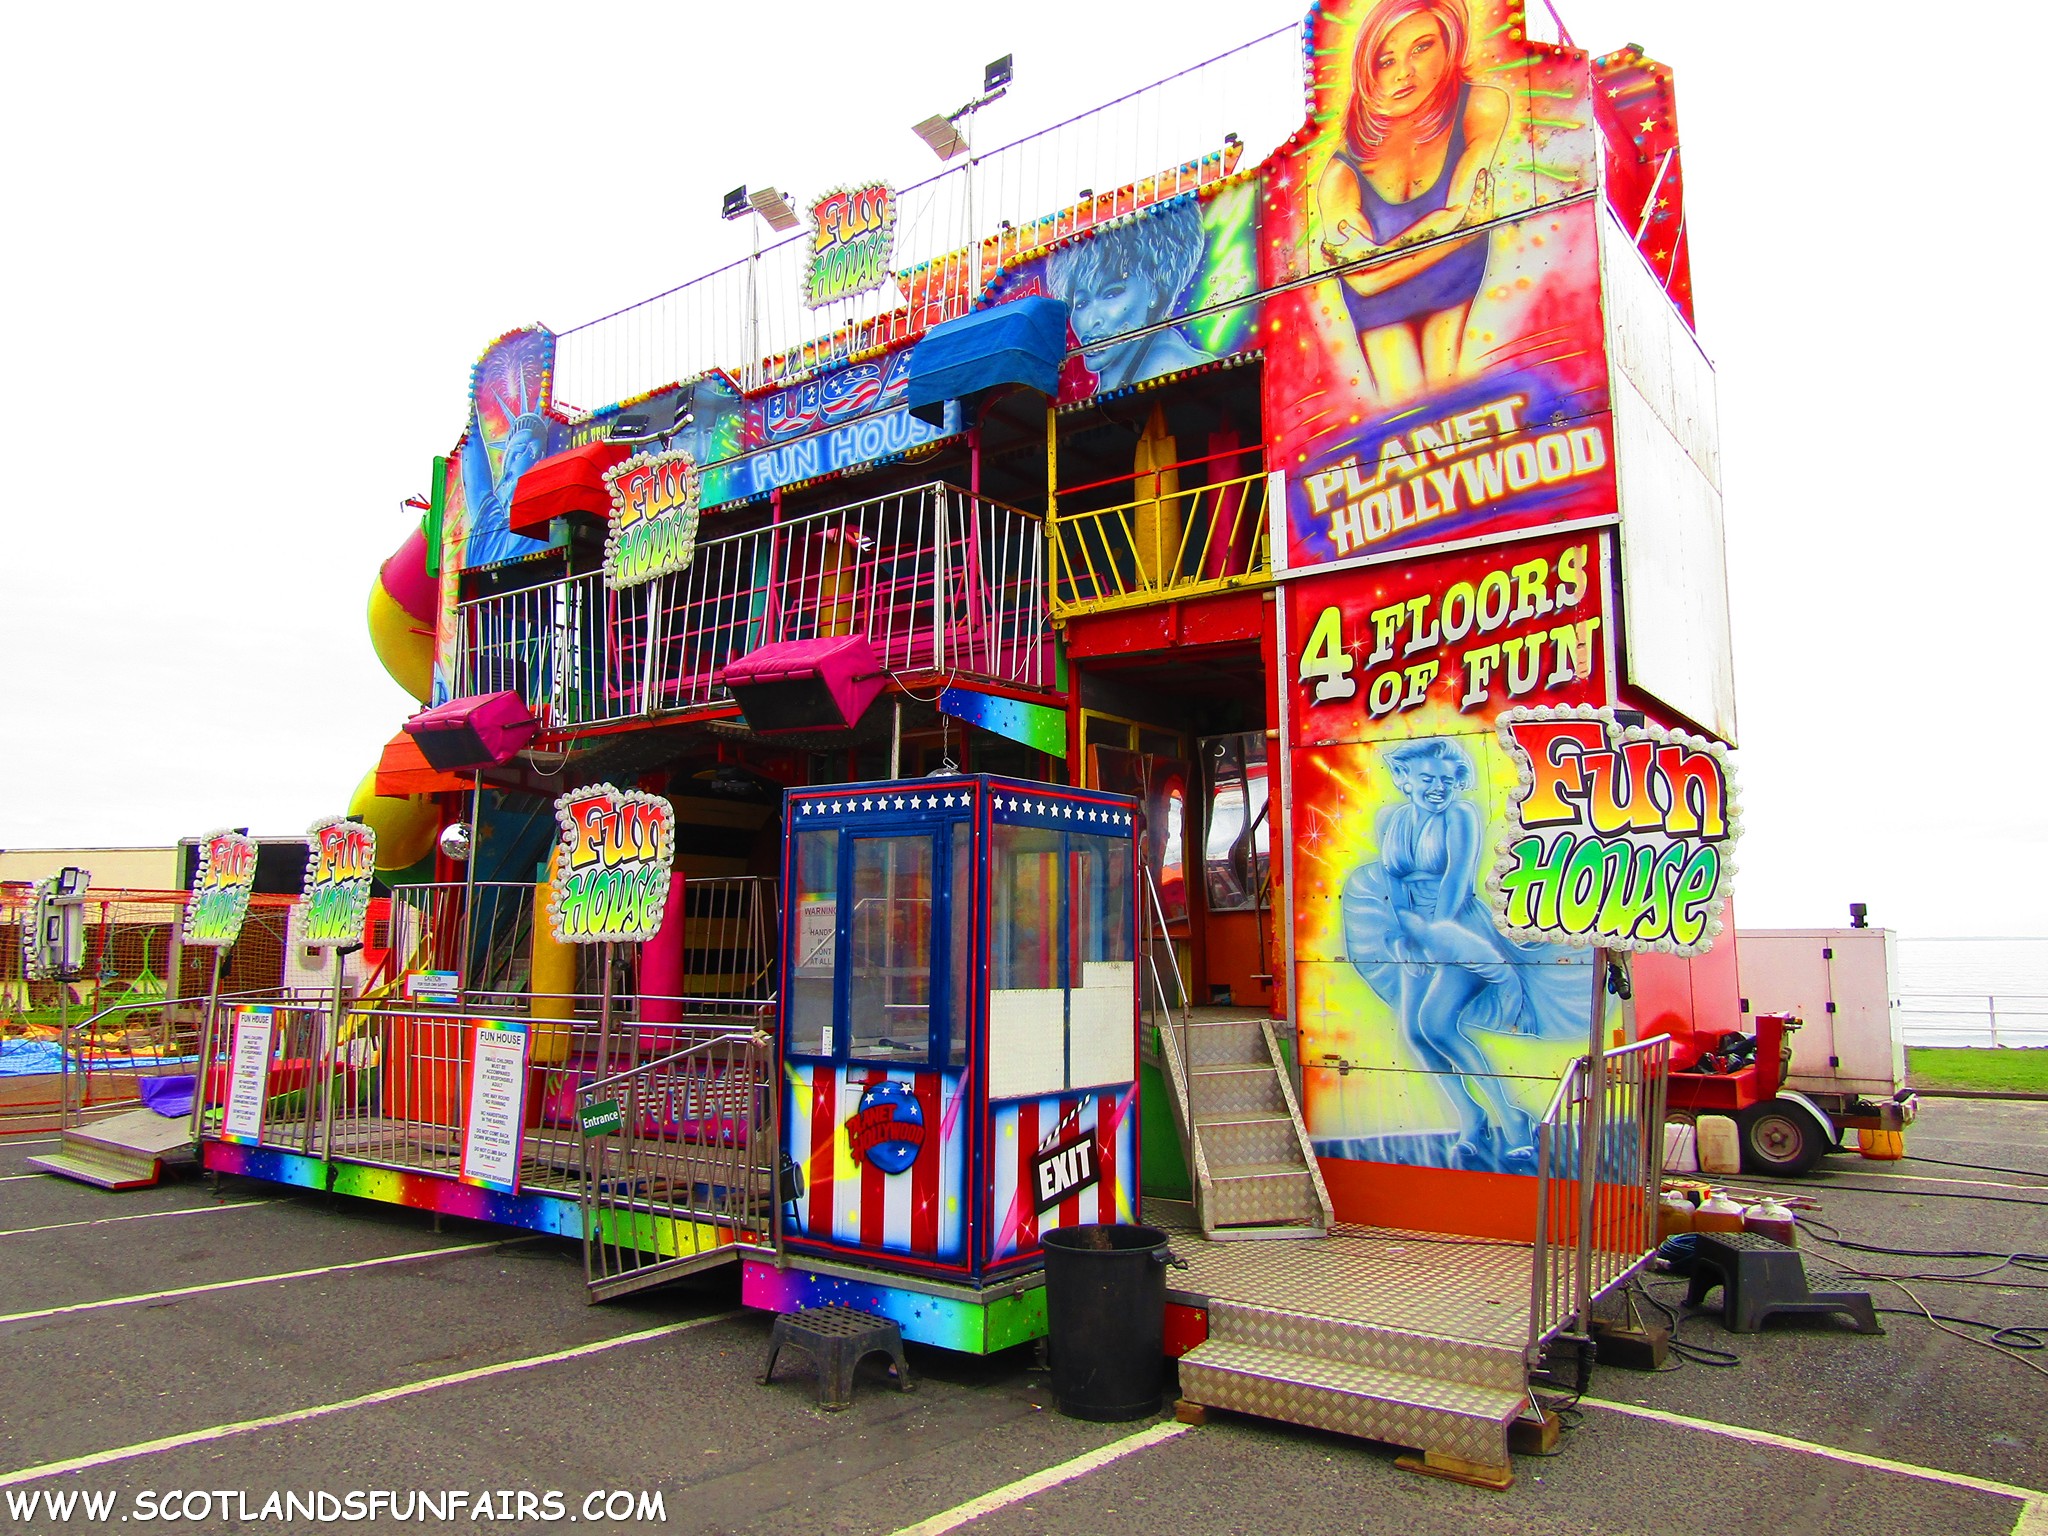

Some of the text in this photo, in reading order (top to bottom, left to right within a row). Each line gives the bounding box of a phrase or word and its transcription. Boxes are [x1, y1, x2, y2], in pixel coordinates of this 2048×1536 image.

[813, 186, 891, 255] Fun
[751, 440, 818, 489] FUN
[1306, 397, 1524, 513] PLANET
[613, 458, 692, 530] Fun
[1329, 426, 1606, 555] HOLLYWOOD
[1299, 544, 1588, 700] 4 FLOORS
[1370, 616, 1600, 714] OF FUN
[1508, 718, 1730, 843] Fun
[568, 794, 668, 870] Fun
[252, 1015, 269, 1024] HOUSE
[480, 1031, 521, 1045] FUN HOUSE
[582, 1109, 619, 1130] Entrance
[845, 1103, 898, 1137] PLANET
[851, 1122, 925, 1169] HOLLYWOOD
[1038, 1138, 1092, 1202] EXIT
